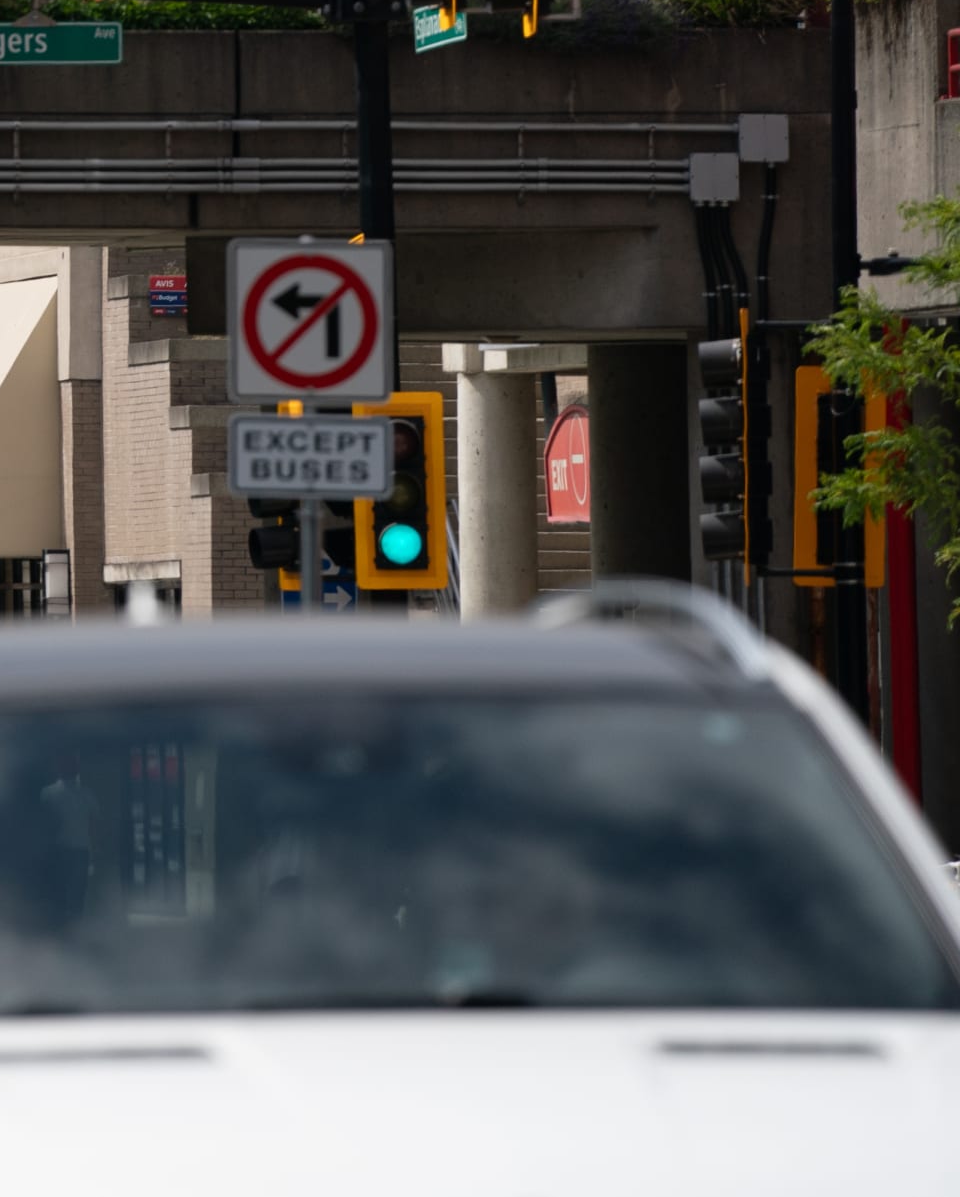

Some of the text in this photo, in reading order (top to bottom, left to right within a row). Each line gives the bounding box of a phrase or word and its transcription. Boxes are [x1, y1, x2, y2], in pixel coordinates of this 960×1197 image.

[94, 27, 116, 39] Ave
[155, 280, 175, 288] AVIS
[244, 431, 376, 453] EXCEPT
[251, 459, 369, 483] BUSES
[552, 459, 568, 492] EXIT
